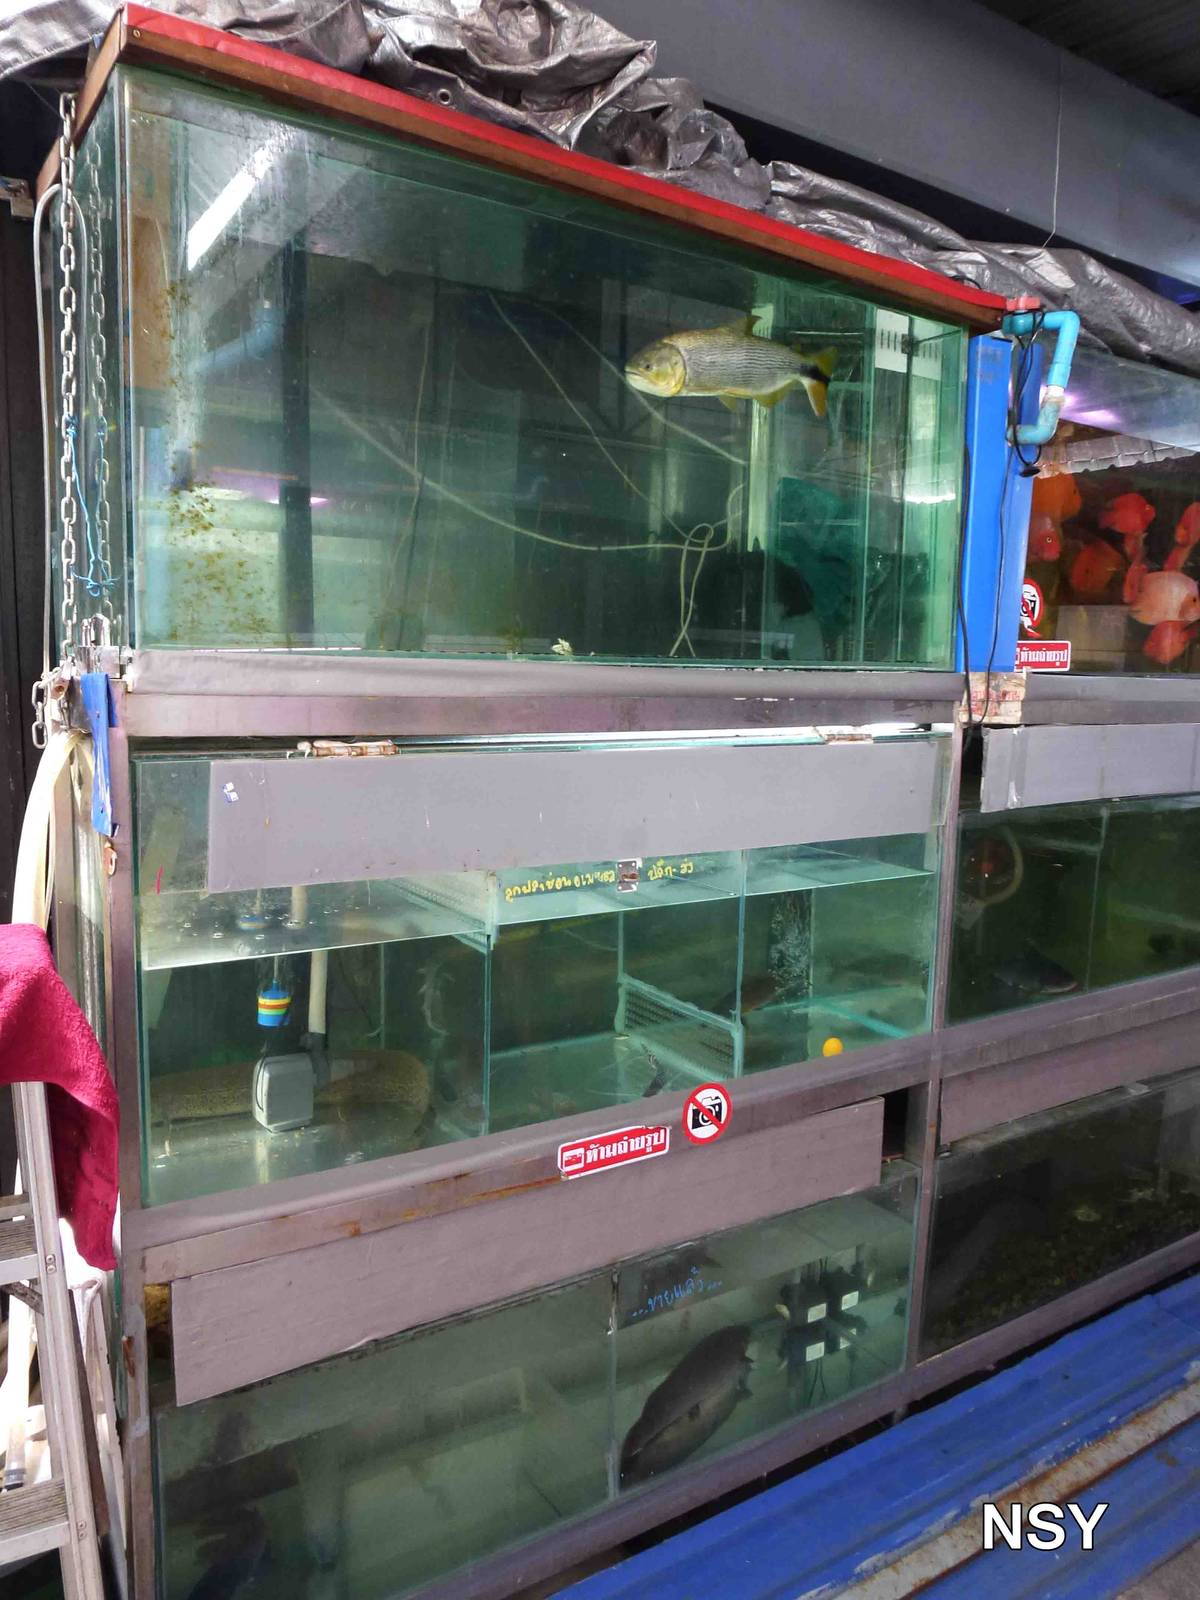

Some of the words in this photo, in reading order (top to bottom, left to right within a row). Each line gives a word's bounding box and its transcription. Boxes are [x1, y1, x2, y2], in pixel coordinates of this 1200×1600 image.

[1020, 647, 1068, 667] ห้ามถ่ายรูป
[586, 1128, 665, 1164] ห้ามถ่ายรูป
